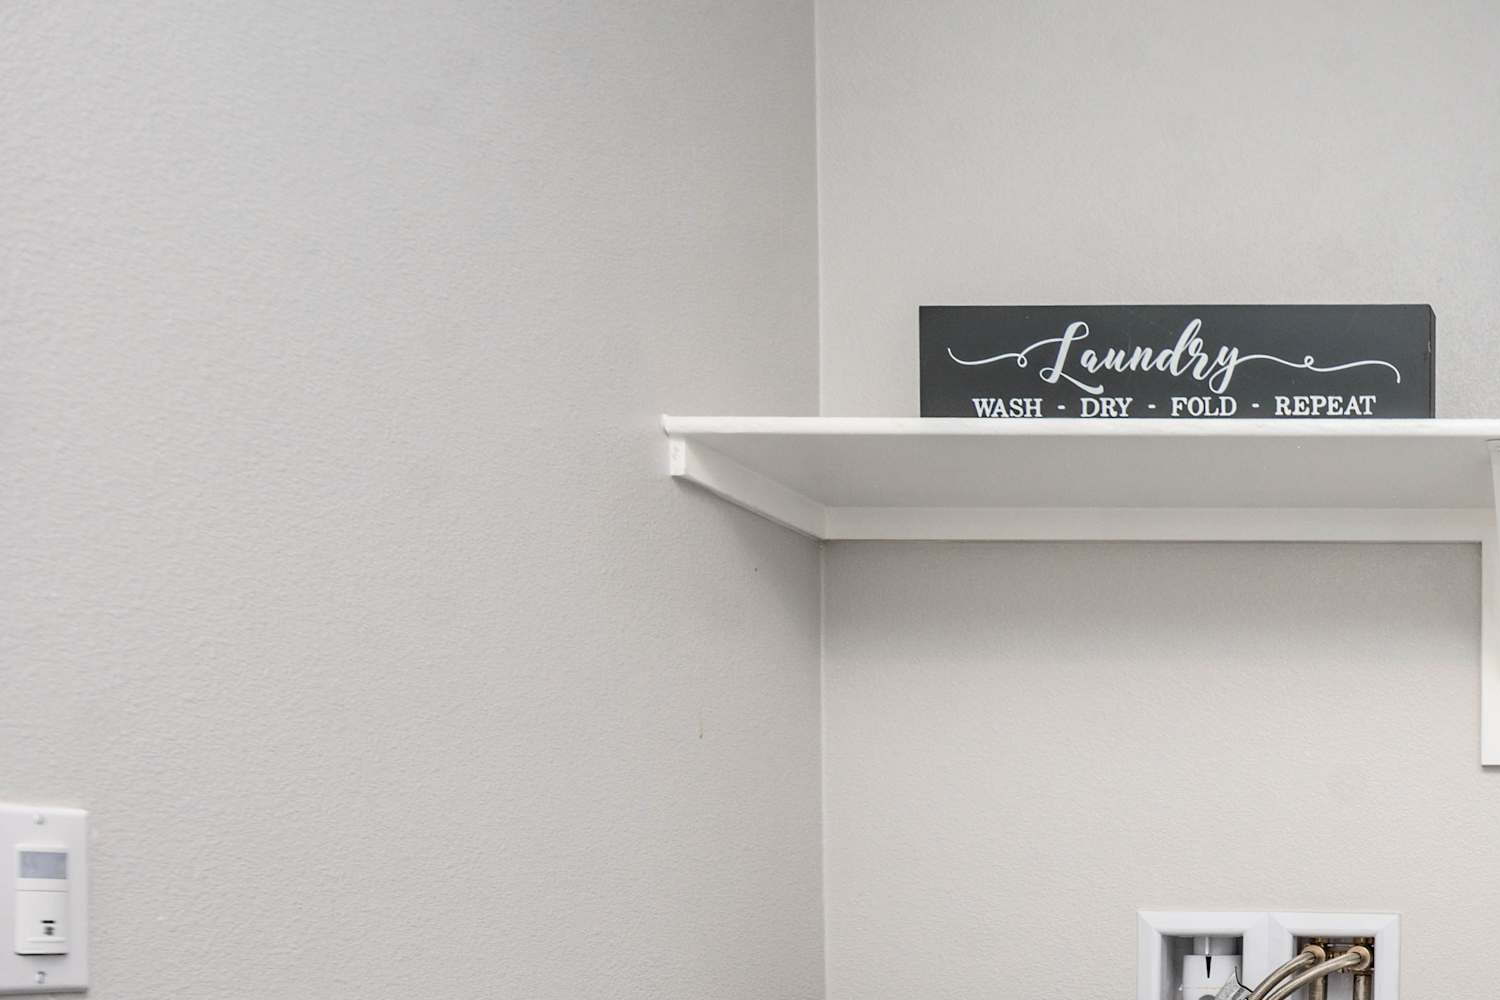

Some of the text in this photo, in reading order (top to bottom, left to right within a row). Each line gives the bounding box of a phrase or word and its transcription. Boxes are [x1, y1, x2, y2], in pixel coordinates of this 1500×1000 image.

[972, 397, 1042, 417] WASH
[1080, 397, 1133, 417] DRY
[1170, 396, 1238, 416] FOLD
[1274, 395, 1377, 416] REPEAT
